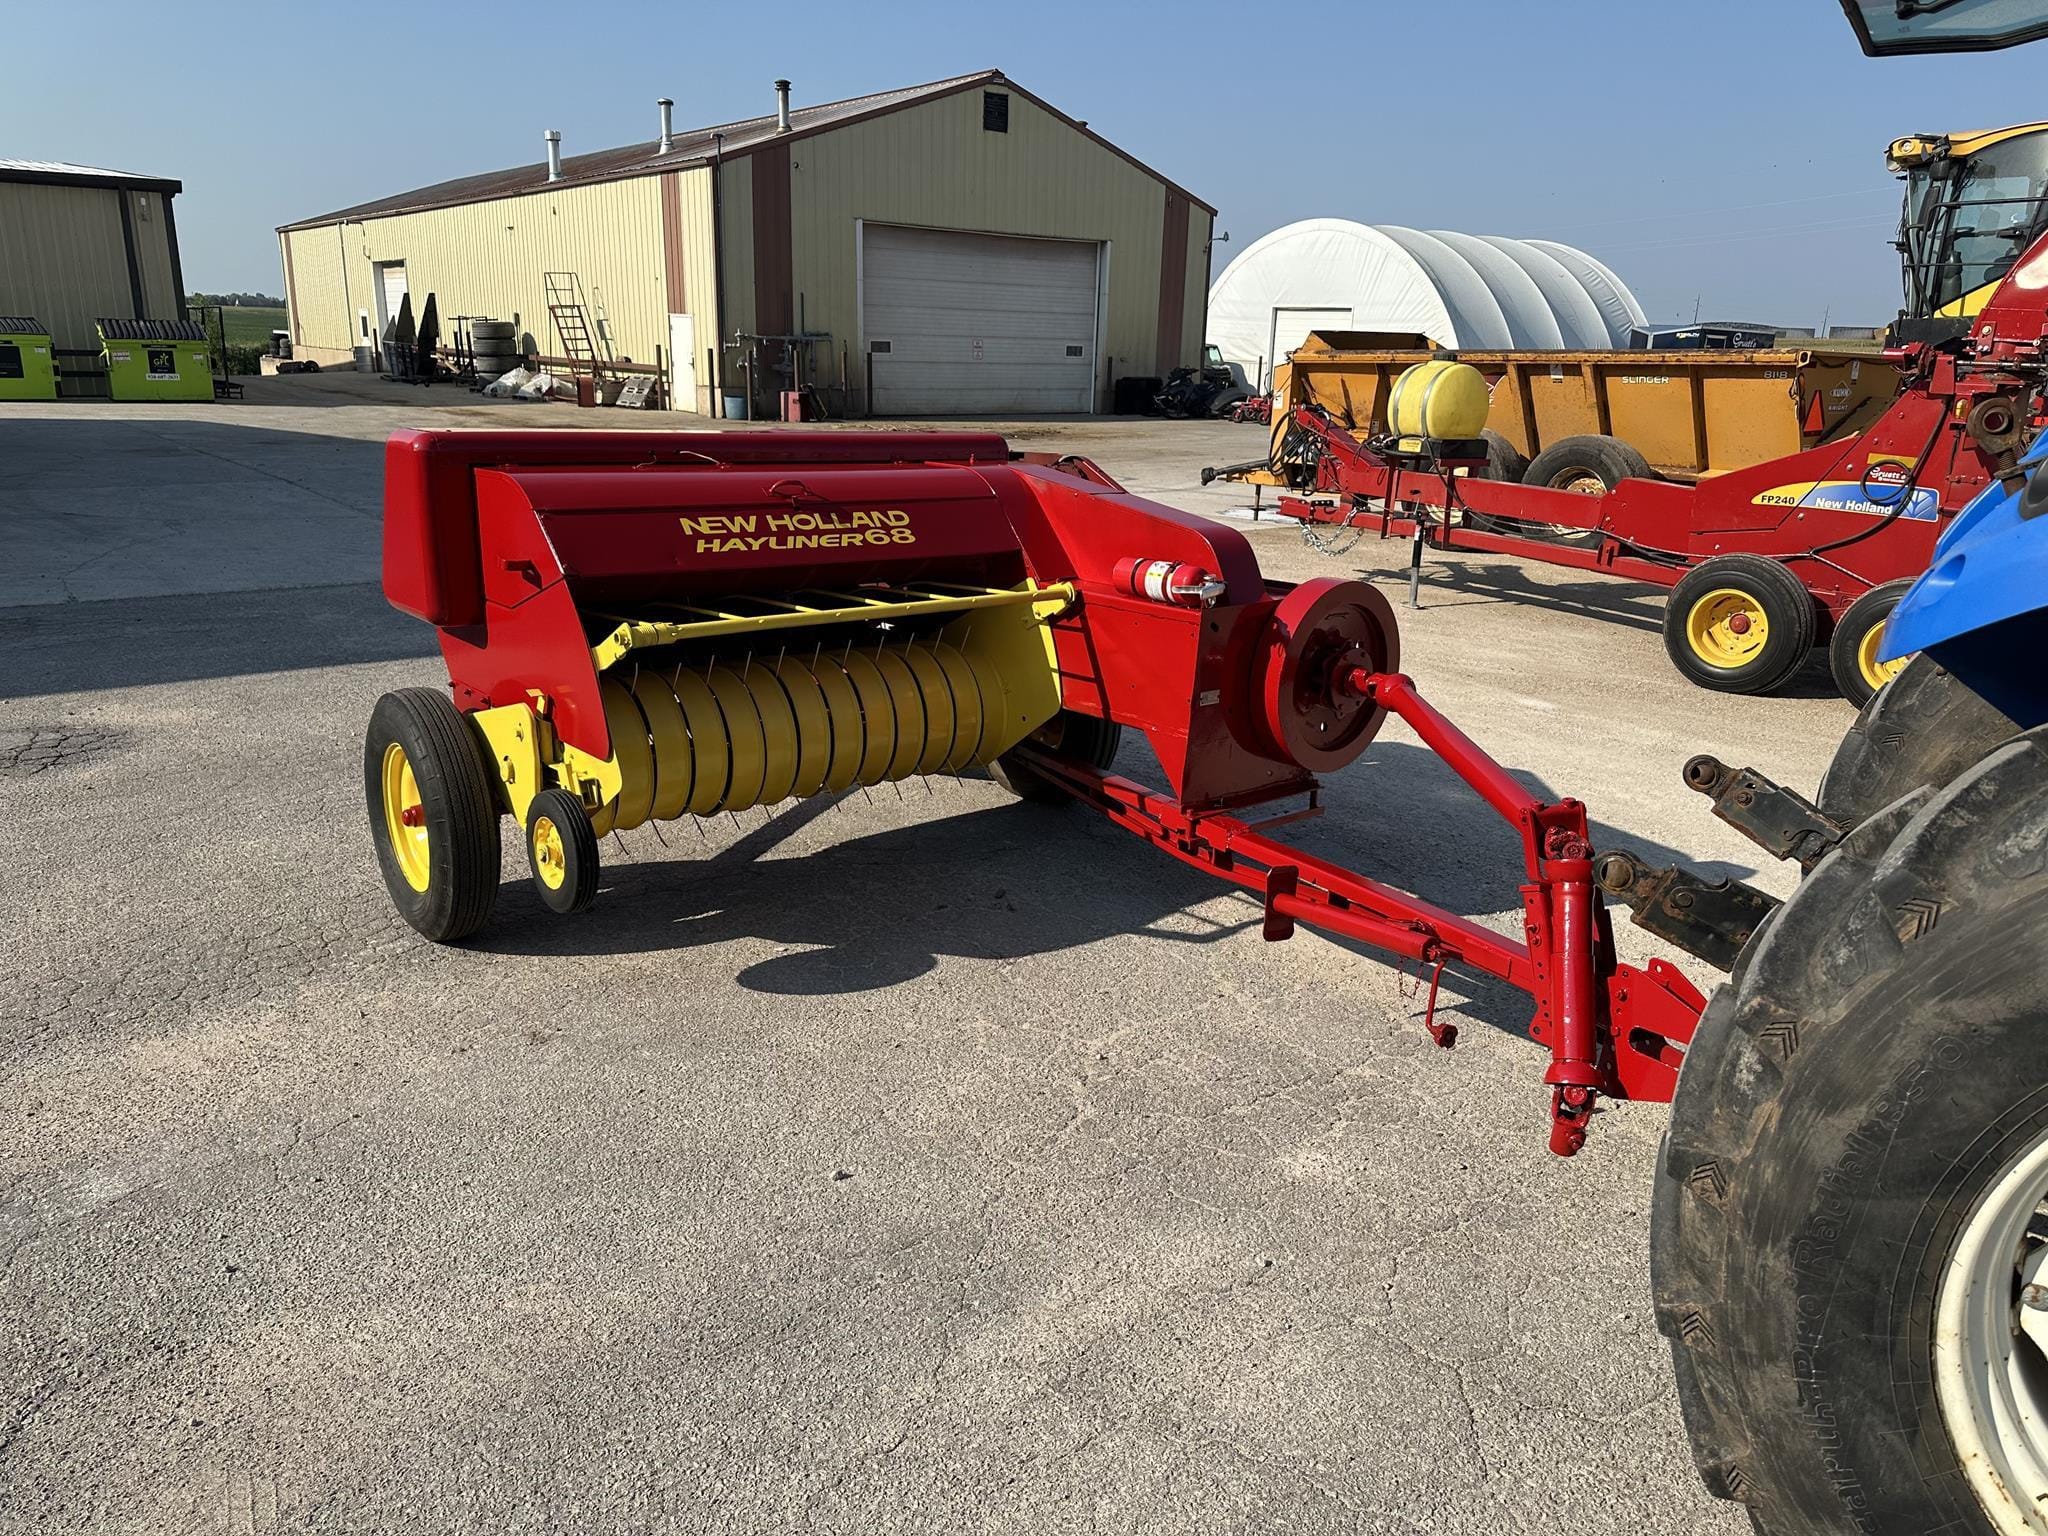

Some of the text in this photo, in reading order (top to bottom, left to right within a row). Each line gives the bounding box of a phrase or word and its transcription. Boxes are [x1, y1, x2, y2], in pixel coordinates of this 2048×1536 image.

[1622, 376, 1670, 384] SLINGER
[1763, 370, 1788, 379] 8118
[1761, 494, 1795, 505] FP240
[1815, 497, 1893, 515] New Holland
[680, 510, 910, 535] NEW HOLLAND
